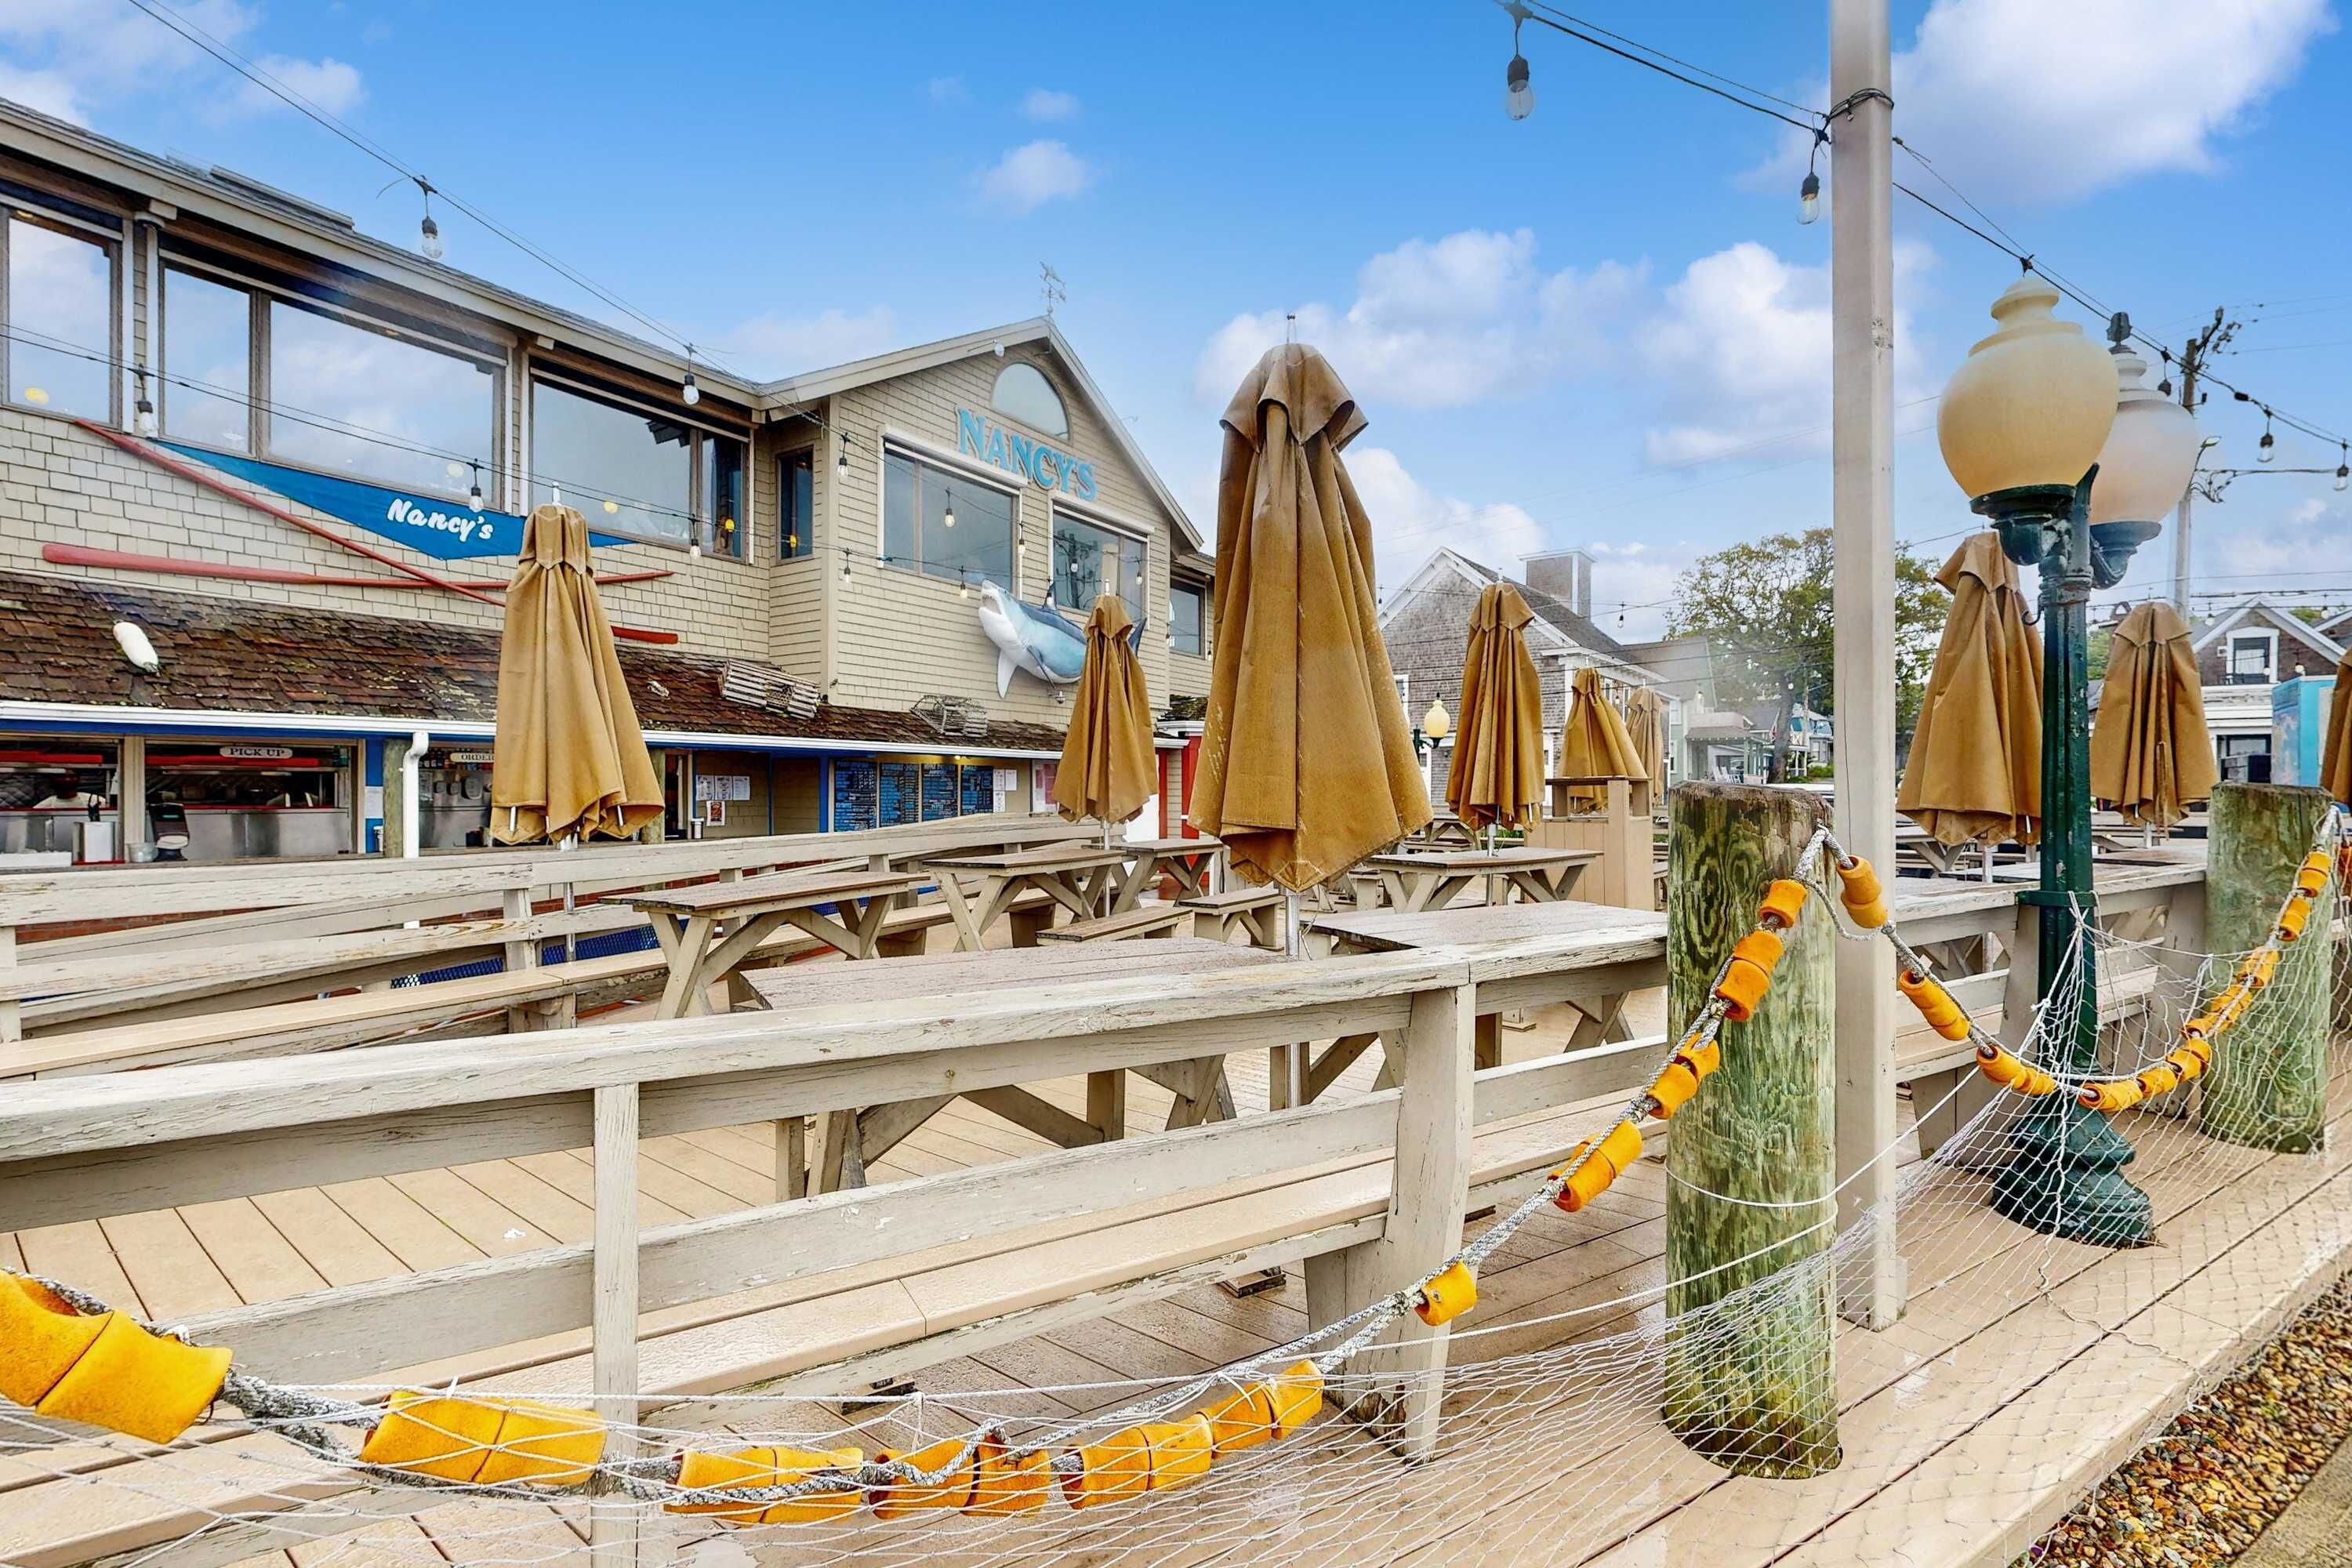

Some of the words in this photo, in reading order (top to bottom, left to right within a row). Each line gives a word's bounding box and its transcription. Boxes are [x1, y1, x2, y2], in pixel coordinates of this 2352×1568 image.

[387, 498, 494, 543] Nancy's
[230, 747, 262, 757] PICK
[267, 749, 285, 757] UP
